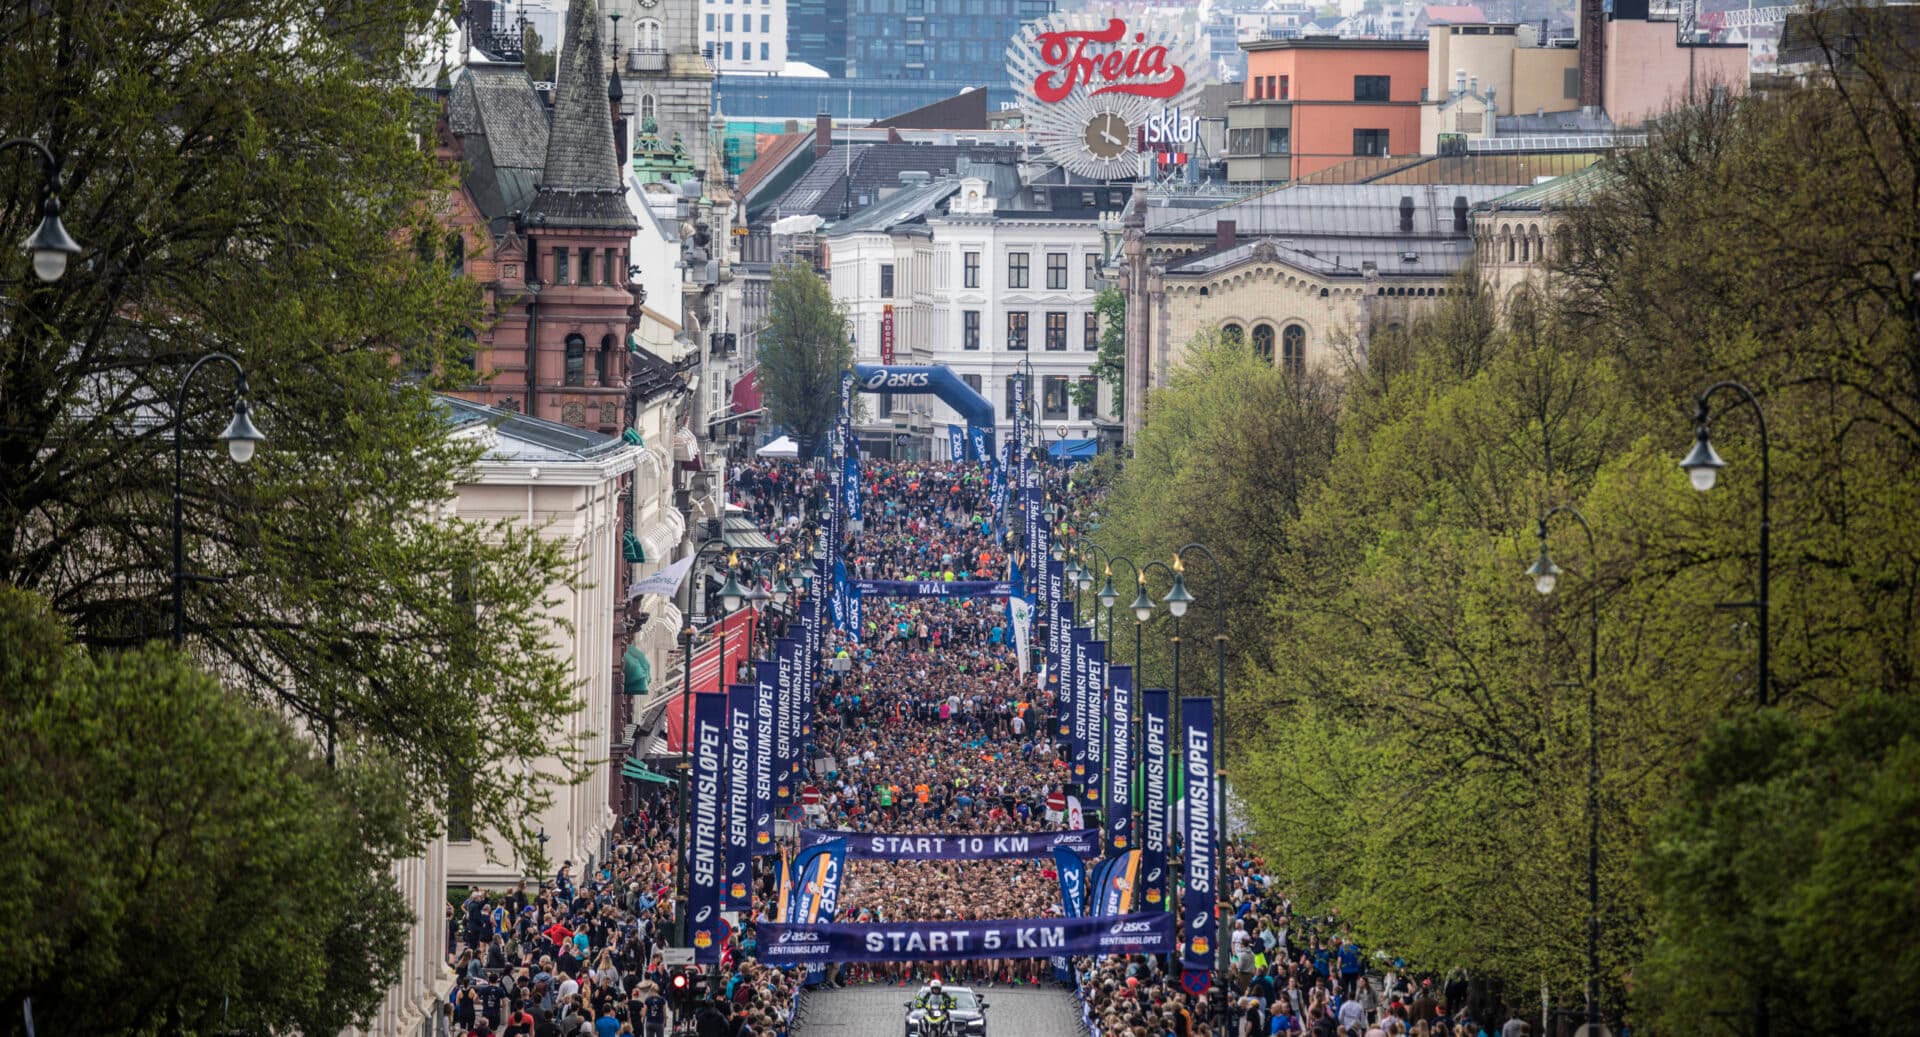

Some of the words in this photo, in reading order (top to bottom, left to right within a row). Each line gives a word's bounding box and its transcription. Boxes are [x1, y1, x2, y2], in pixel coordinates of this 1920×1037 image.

[1034, 18, 1186, 103] Freia
[1144, 106, 1200, 143] isklar
[887, 372, 929, 387] asics
[919, 582, 949, 594] MÅL
[1060, 616, 1071, 703] SENTRUMSLØPET
[757, 682, 774, 800] SENTRUMSLØPET
[778, 656, 792, 760] SENTRUMSLØPET
[1088, 658, 1102, 762] SENTRUMSLØPET
[1114, 686, 1128, 805] SENTRUMSLØPET
[694, 720, 720, 888] SENTRUMSLØPET
[731, 707, 750, 847] SENTRUMSLØPET
[1147, 713, 1164, 853] SENTRUMSLØPET
[1188, 726, 1210, 893] SENTRUMSLØPET
[820, 860, 838, 914] asics
[871, 837, 946, 853] START
[958, 838, 984, 853] 10
[994, 837, 1029, 852] KM
[791, 932, 819, 941] asics
[866, 931, 970, 952] START
[984, 930, 1001, 949] 5
[1016, 927, 1065, 948] KM
[1123, 921, 1151, 931] asics
